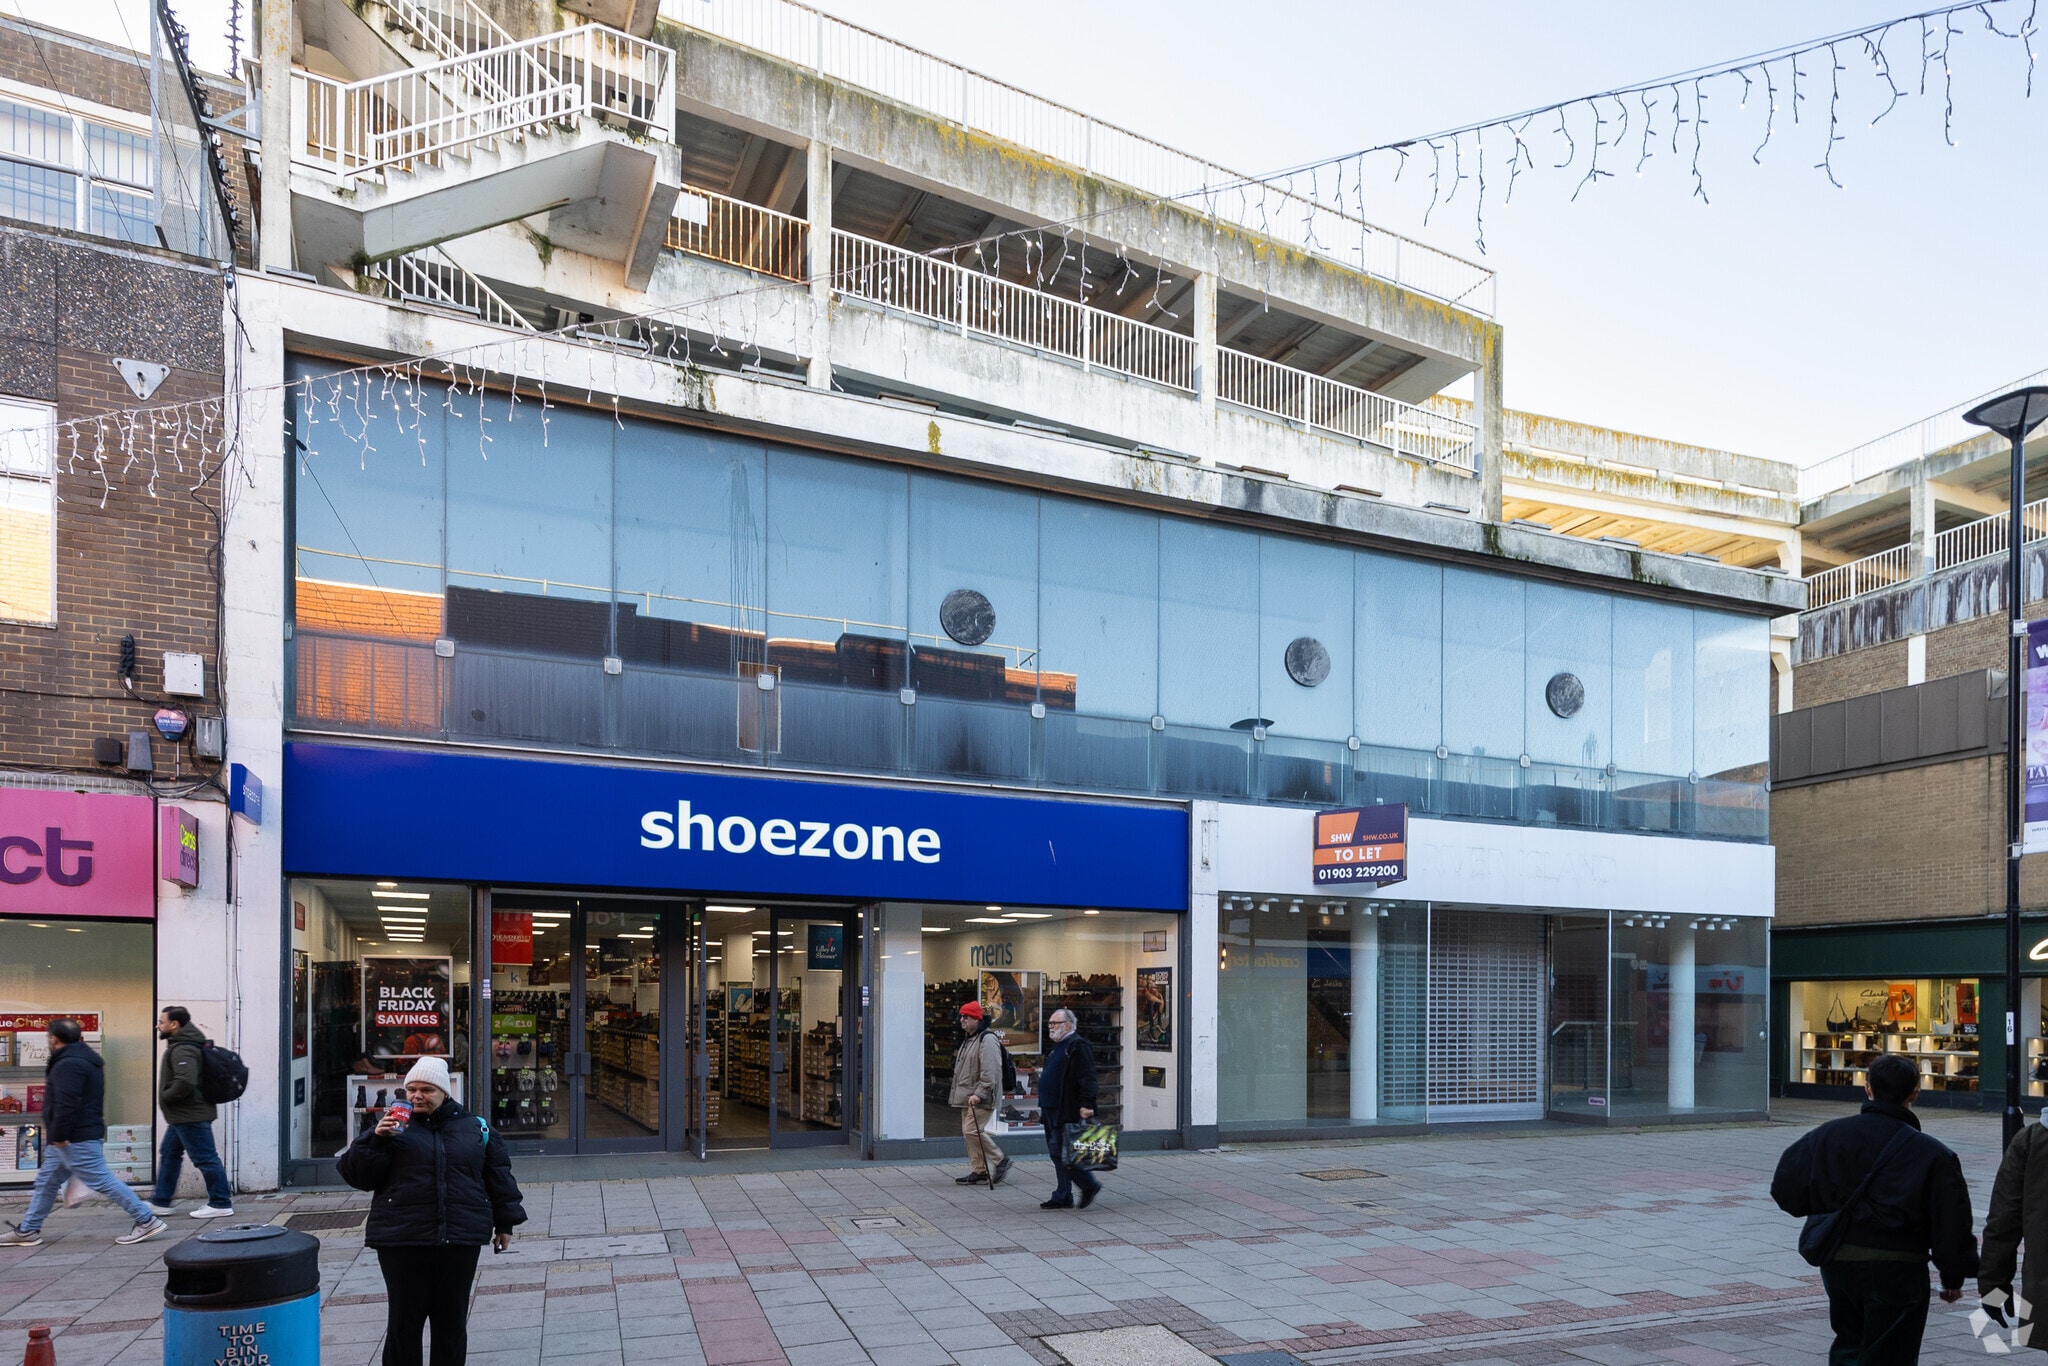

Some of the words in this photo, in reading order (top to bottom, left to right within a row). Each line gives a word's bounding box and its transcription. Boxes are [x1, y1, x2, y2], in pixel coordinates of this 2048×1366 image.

[180, 824, 197, 851] Cards
[640, 799, 941, 864] shoezone
[1330, 833, 1352, 843] SHW
[1362, 832, 1399, 842] SHW.CO.UK
[0, 827, 94, 887] ct
[1334, 848, 1354, 862] TO
[1358, 846, 1382, 861] LET
[1319, 867, 1353, 880] 01903
[1355, 864, 1399, 878] 229200
[970, 941, 1013, 968] mens
[379, 987, 434, 998] BLACK
[378, 1000, 436, 1011] FRIDAY
[377, 1014, 438, 1025] SAVINGS
[219, 1322, 265, 1336] TIME
[229, 1334, 255, 1346] TO
[226, 1345, 258, 1358] BIN
[215, 1354, 269, 1366] YOUR
